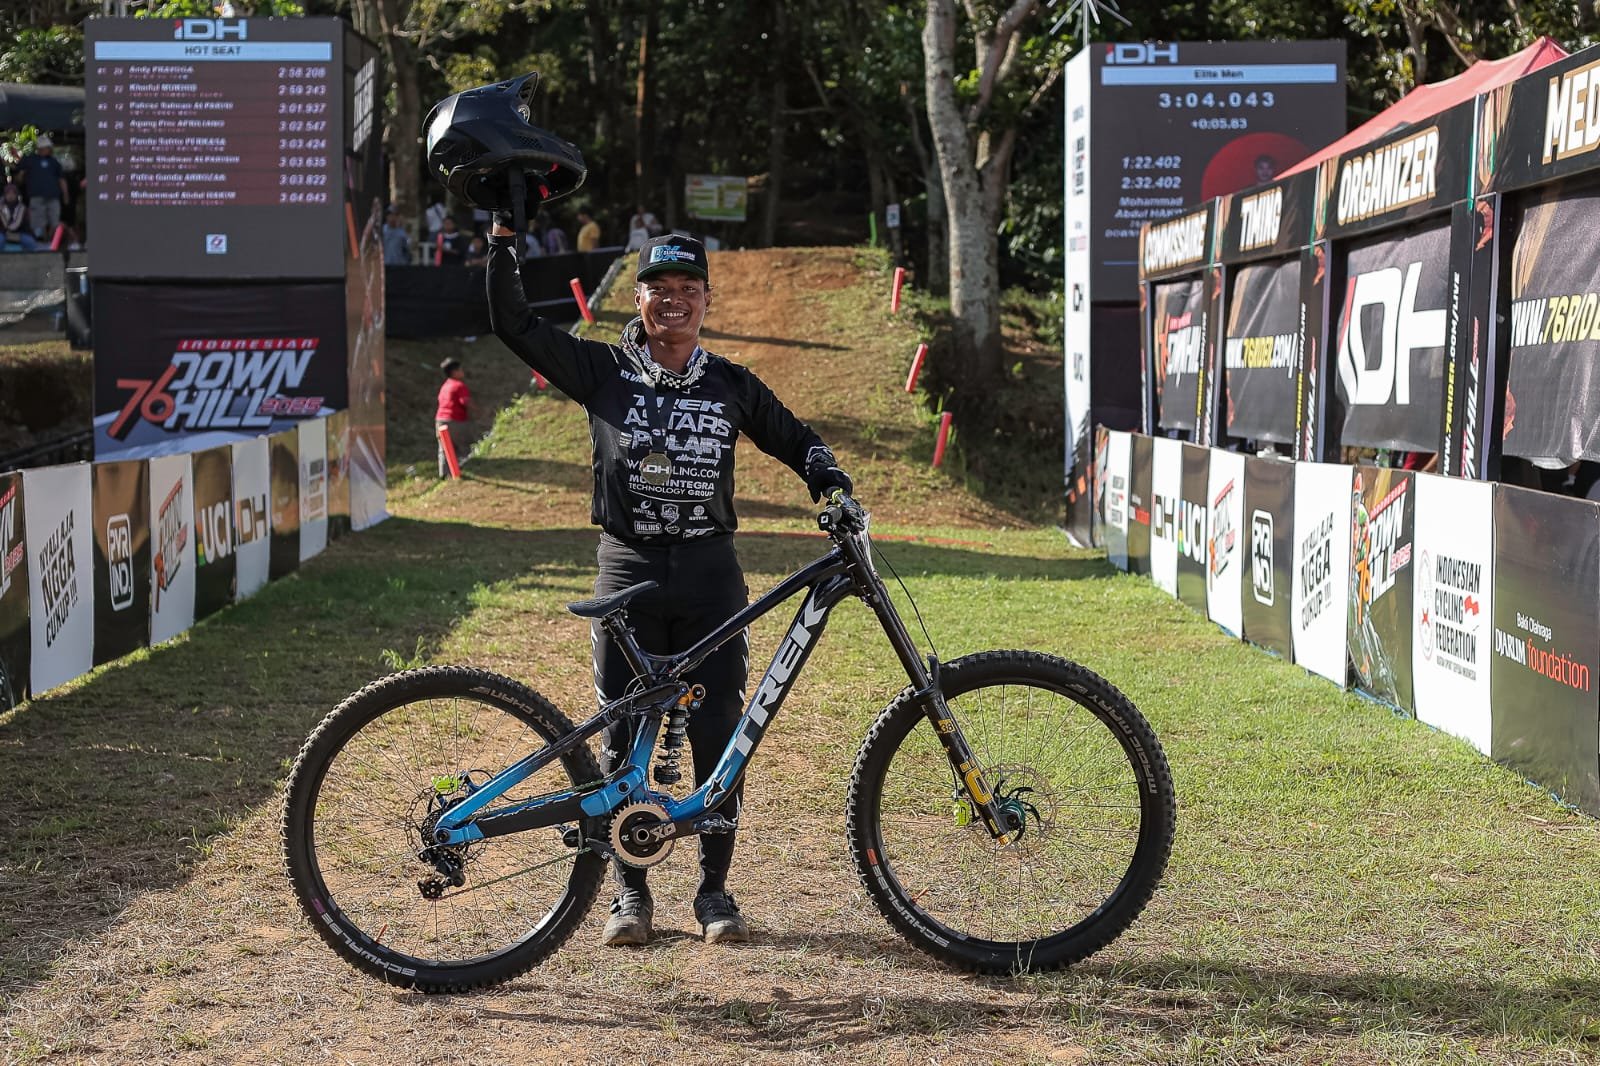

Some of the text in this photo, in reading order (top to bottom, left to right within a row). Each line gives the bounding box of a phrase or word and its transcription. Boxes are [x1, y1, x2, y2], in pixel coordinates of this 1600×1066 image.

[184, 46, 241, 56] HOT SEAT
[1194, 69, 1243, 79] Elite Men
[1121, 176, 1182, 189] 2:32.402
[1122, 155, 1182, 169] 1:22.402
[1337, 130, 1440, 226] ORGANIZER
[1115, 209, 1148, 218] Abdul
[1119, 197, 1184, 207] Mohammad
[1240, 188, 1284, 252] TIMING
[181, 339, 314, 351] INDONESIAN
[169, 350, 315, 395] DOWN
[107, 364, 177, 438] 76
[163, 388, 273, 429] HILL
[628, 482, 715, 497] TECHNOLOGY GROUP
[60, 508, 75, 538] AJA
[201, 500, 232, 565] UCI
[1182, 499, 1207, 565] UCI
[109, 527, 129, 564] PYR
[41, 536, 76, 617] NGGA
[1301, 538, 1331, 603] NGGA
[1436, 554, 1481, 594] INDONESIAN
[46, 595, 70, 649] CUKUP
[1435, 588, 1463, 625] CYCLING
[1435, 622, 1477, 665] FEDERATION
[1495, 628, 1526, 665] DJARUM
[1526, 638, 1589, 691] foundation
[727, 594, 829, 760] TREK
[872, 864, 950, 948] SCHWALBE
[321, 911, 417, 977] SCHWALBE
